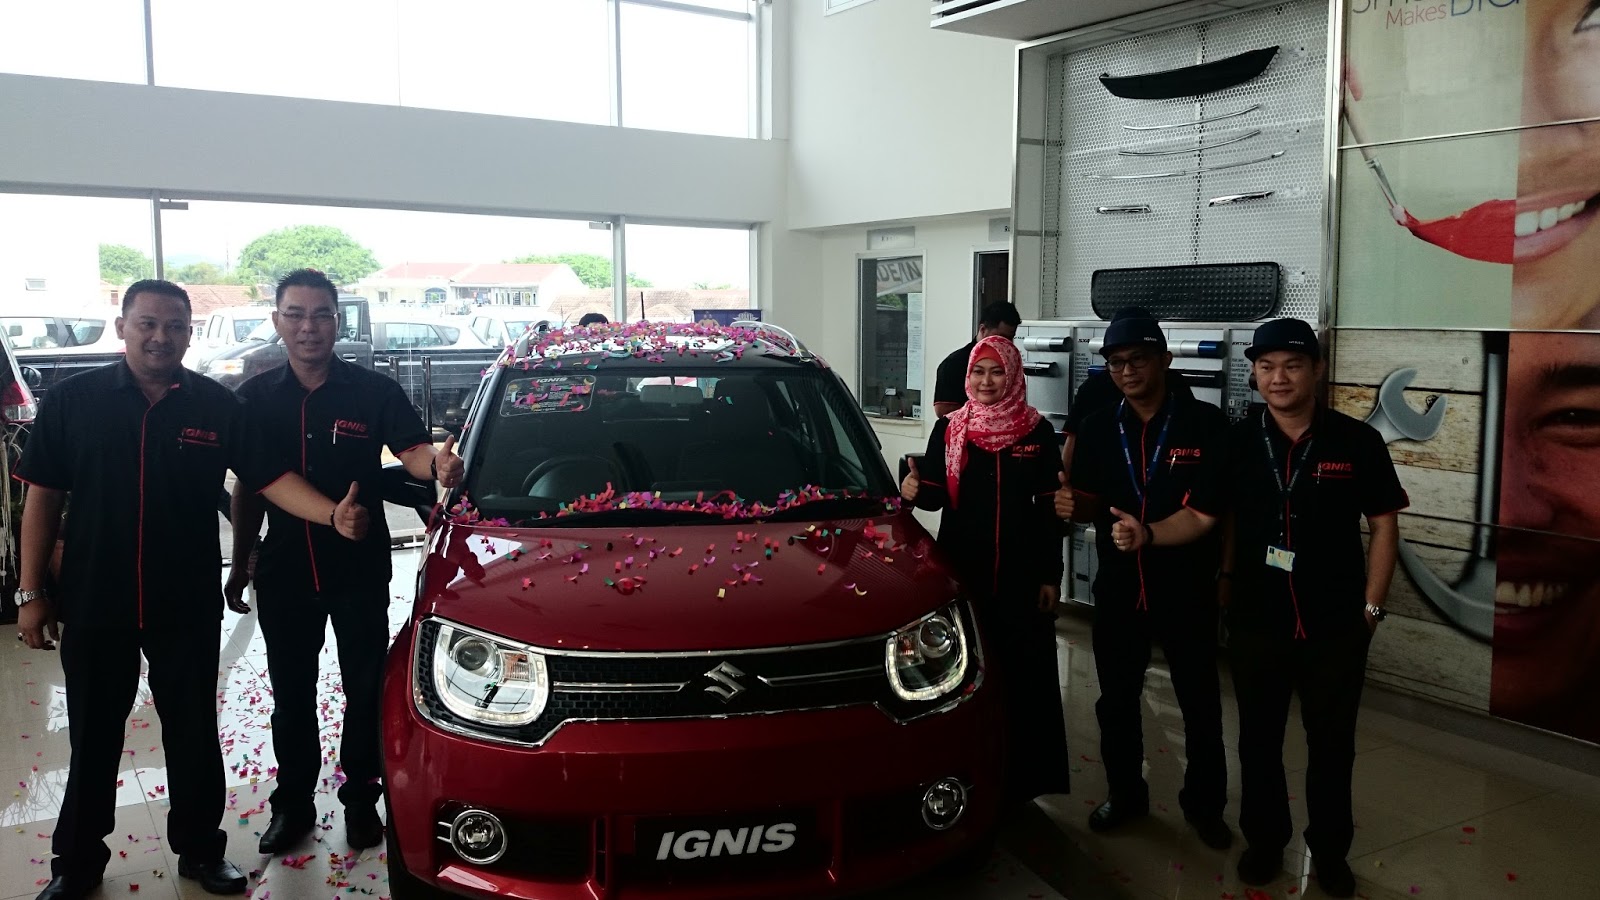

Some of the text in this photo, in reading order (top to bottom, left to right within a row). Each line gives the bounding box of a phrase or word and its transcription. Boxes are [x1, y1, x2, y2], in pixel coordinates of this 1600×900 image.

[1386, 4, 1447, 29] Makes
[1169, 448, 1200, 457] IGNIS
[656, 822, 797, 860] IGNIS
